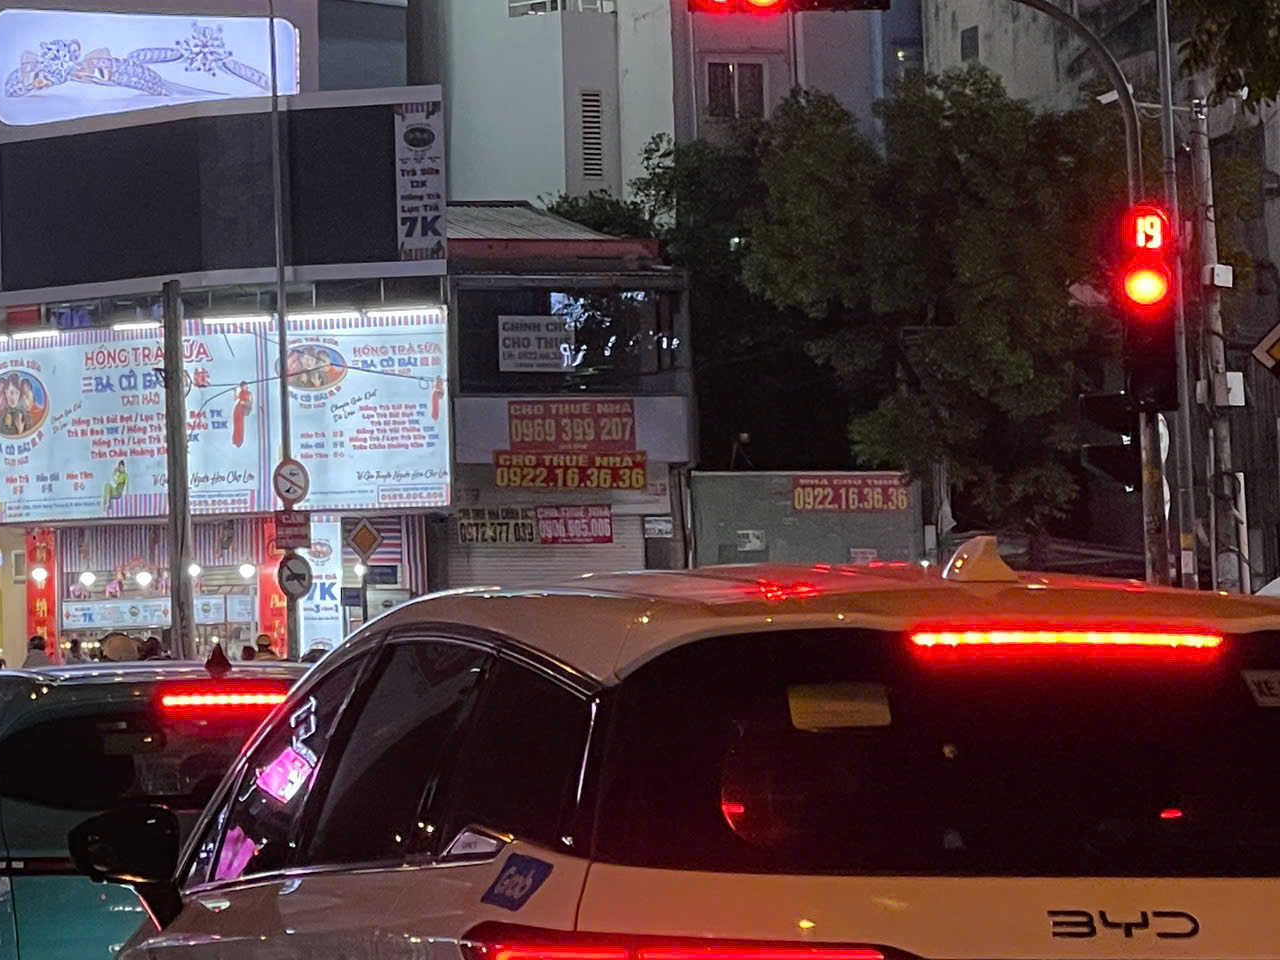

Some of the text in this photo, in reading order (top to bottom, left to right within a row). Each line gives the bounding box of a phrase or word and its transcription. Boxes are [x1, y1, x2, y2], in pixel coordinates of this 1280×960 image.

[400, 215, 443, 238] 7K
[1136, 215, 1162, 249] 19
[131, 341, 166, 367] TRÀ
[183, 339, 213, 363] ỮA
[502, 336, 530, 349] CHO
[511, 417, 633, 441] 0969 399 207
[495, 467, 645, 489] 0922.16.36.36
[794, 488, 907, 511] 0922.16.36.36
[1047, 909, 1200, 939] BYD
